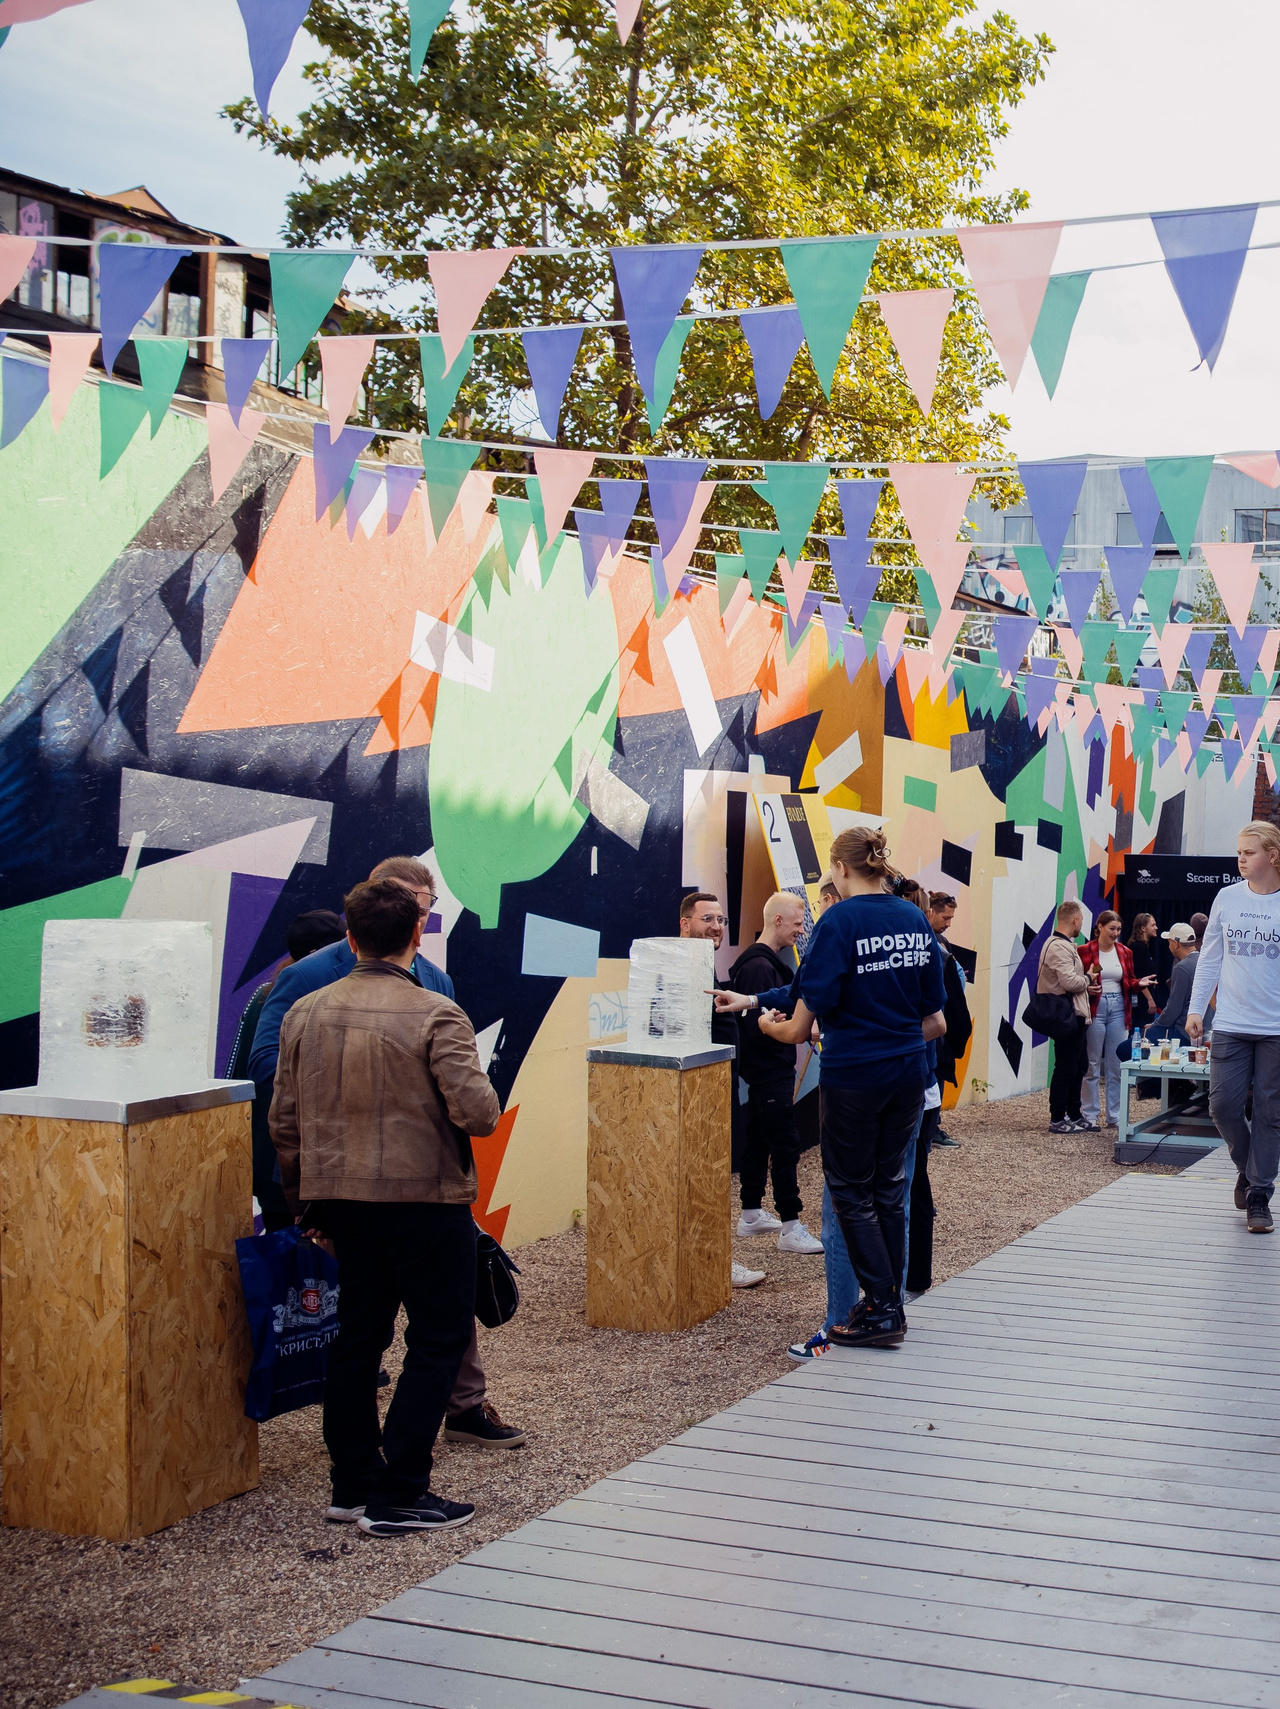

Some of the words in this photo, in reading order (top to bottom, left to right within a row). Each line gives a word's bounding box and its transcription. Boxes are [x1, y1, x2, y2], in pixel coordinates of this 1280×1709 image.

[762, 801, 781, 842] 2
[1227, 924, 1251, 939] bar
[1254, 926, 1280, 943] hub
[1228, 940, 1280, 960] EXPO
